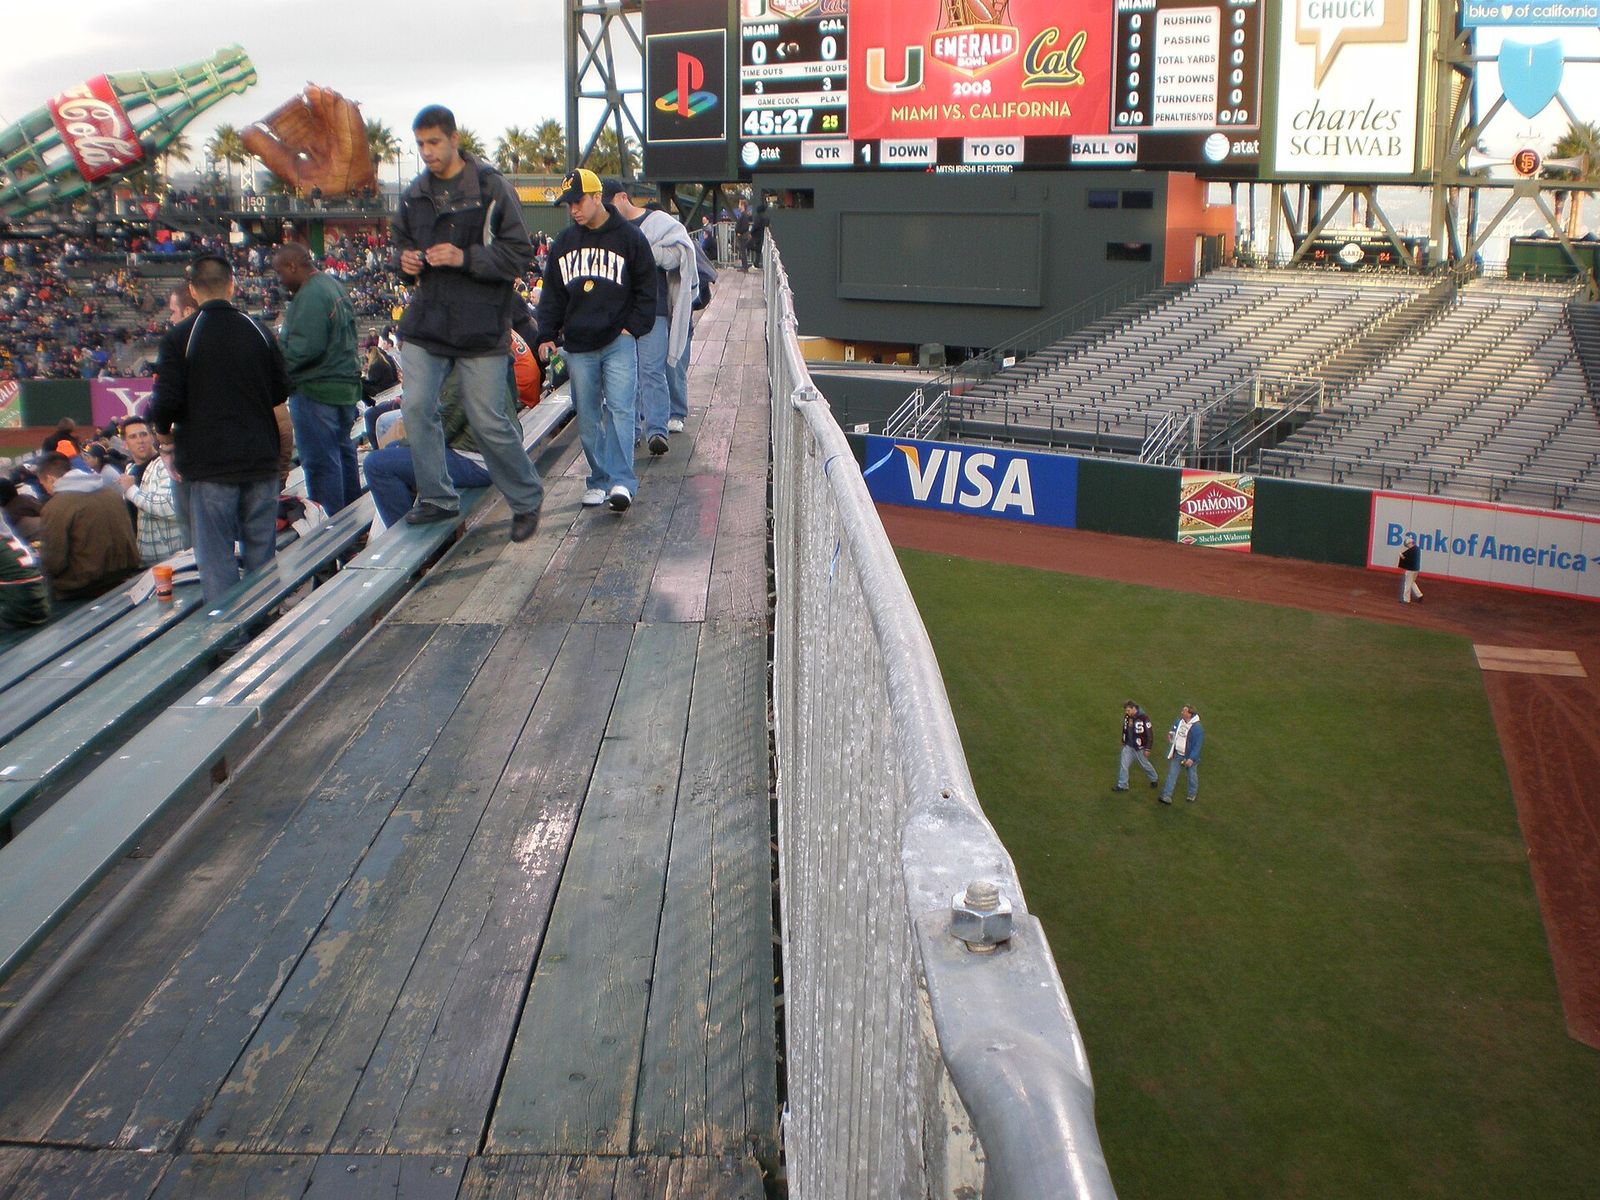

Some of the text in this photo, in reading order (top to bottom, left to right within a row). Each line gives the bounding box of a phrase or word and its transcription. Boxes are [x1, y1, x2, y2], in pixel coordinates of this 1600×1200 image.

[1118, 0, 1156, 9] MIAMI
[1308, 0, 1375, 19] CHUCK
[1469, 4, 1597, 17] blue of california
[1131, 14, 1141, 28] 0
[1163, 15, 1212, 25] RUSHING
[1235, 9, 1245, 24] 0
[742, 24, 779, 37] MIAMI
[819, 19, 845, 31] CAL
[1131, 33, 1141, 48] 0
[1164, 35, 1210, 45] PASSING
[1234, 29, 1245, 44] 0
[752, 41, 766, 64] 0
[821, 36, 837, 60] 0
[934, 34, 1013, 57] EMERALD
[957, 56, 988, 68] BOWL
[1021, 26, 1088, 89] Cal
[1130, 52, 1140, 67] 0
[1158, 55, 1216, 64] TOTAL YARDS
[1233, 49, 1244, 64] 0
[866, 45, 924, 92] U
[1129, 72, 1140, 86] 0
[1157, 74, 1215, 84] 1ST DOWNS
[1232, 68, 1243, 84] 0
[755, 81, 764, 94] 3
[823, 77, 832, 91] 3
[952, 80, 992, 96] 2008
[777, 97, 800, 105] CLOCK
[1129, 91, 1139, 105] 0
[1156, 94, 1214, 104] TURNOVERS
[1232, 89, 1242, 104] 0
[891, 100, 1071, 121] MIAMI VS. CALIFORNIA
[1119, 111, 1143, 124] 0/0
[1155, 112, 1213, 122] PENALTIES/YDS
[1292, 99, 1402, 130] charles
[744, 109, 813, 134] 45:27
[822, 115, 838, 128] 25
[760, 146, 780, 159] at&t
[815, 147, 840, 158] QTR
[889, 145, 928, 157] DOWN
[971, 144, 1015, 156] TO GO
[1072, 142, 1136, 154] BALL ON
[1232, 139, 1259, 154] at&t
[1291, 135, 1402, 156] SCHWAB
[861, 143, 871, 163] 1
[894, 444, 1035, 516] VISA
[1187, 496, 1248, 514] DIAMOND
[1198, 534, 1223, 543] Shelled
[1223, 533, 1250, 542] Walnuts
[1451, 533, 1479, 557] of
[1480, 535, 1587, 572] America
[1135, 721, 1145, 734] S
